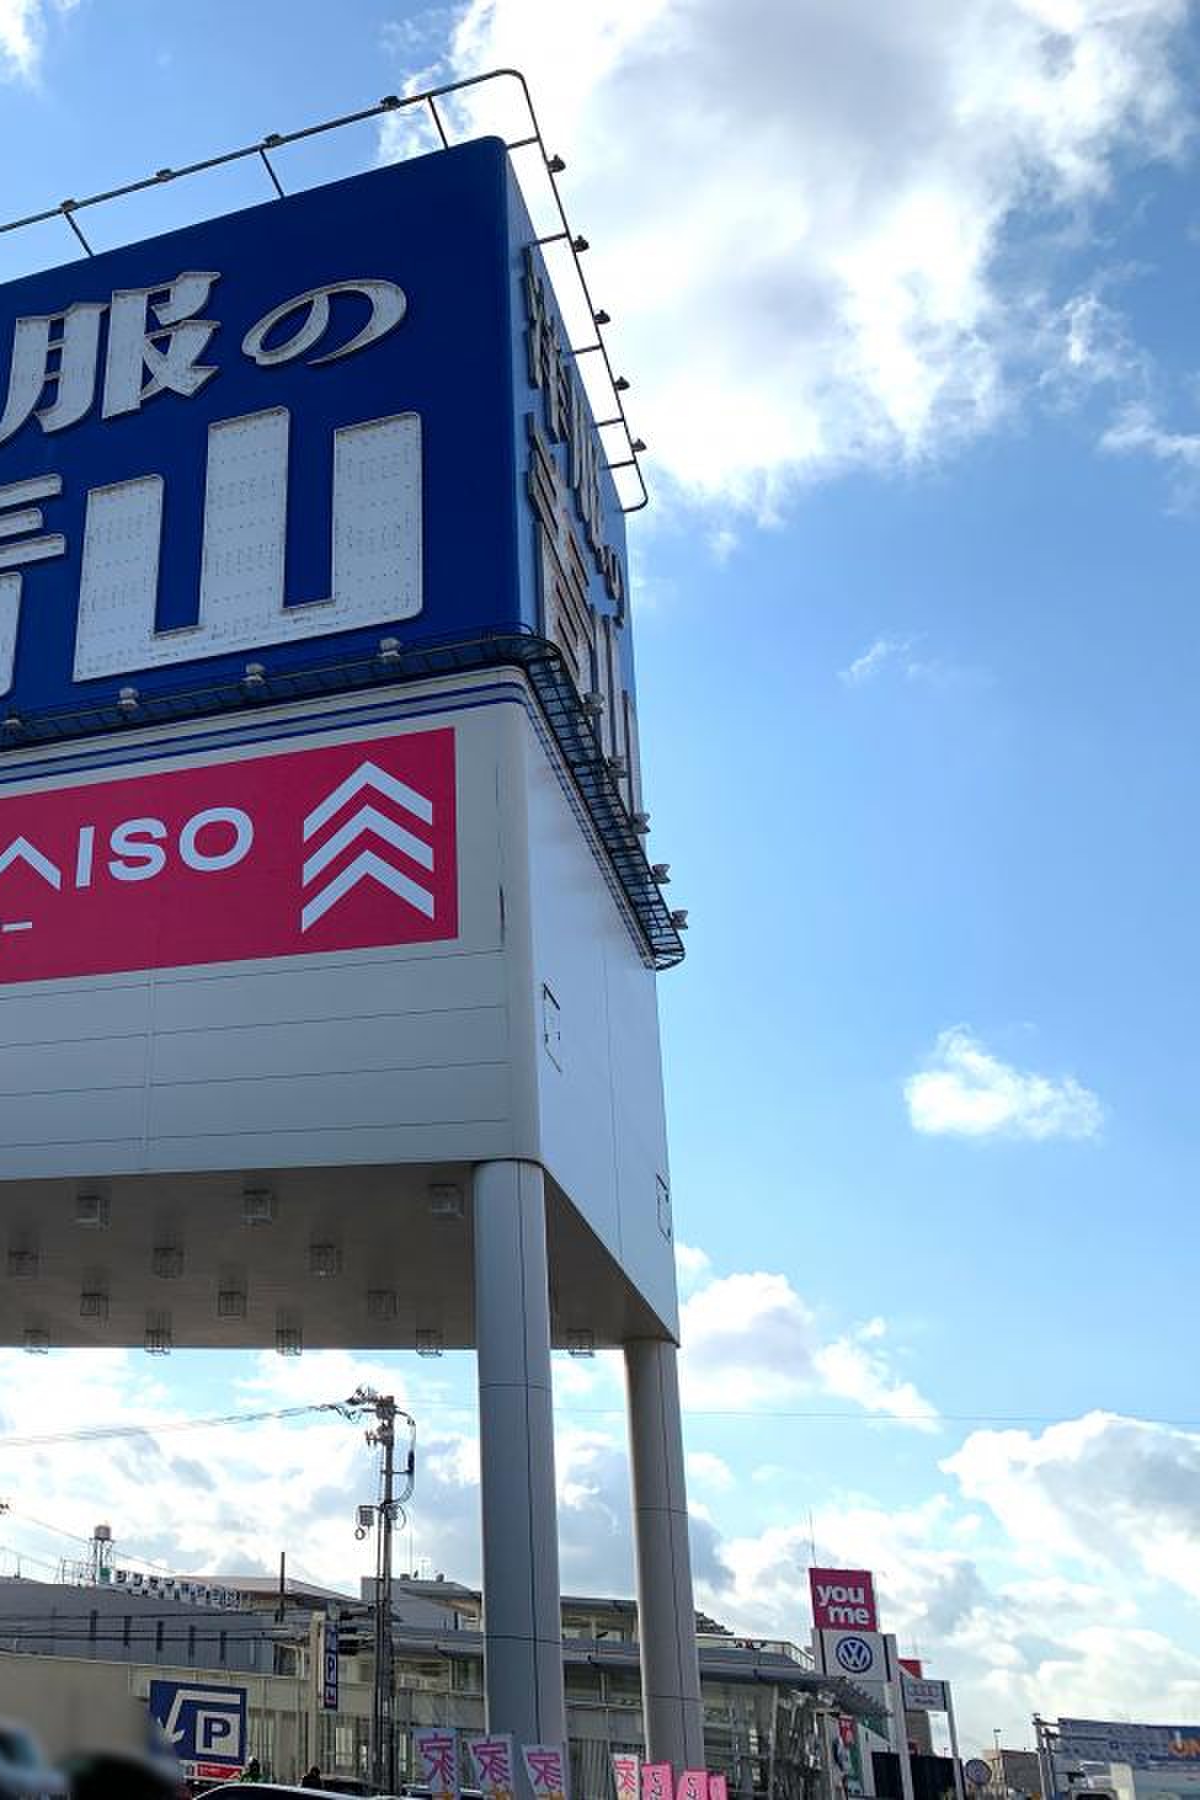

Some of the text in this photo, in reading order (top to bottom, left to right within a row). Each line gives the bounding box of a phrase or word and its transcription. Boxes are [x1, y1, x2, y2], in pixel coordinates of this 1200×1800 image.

[816, 1584, 865, 1607] you
[828, 1605, 870, 1625] me
[202, 1716, 231, 1749] P
